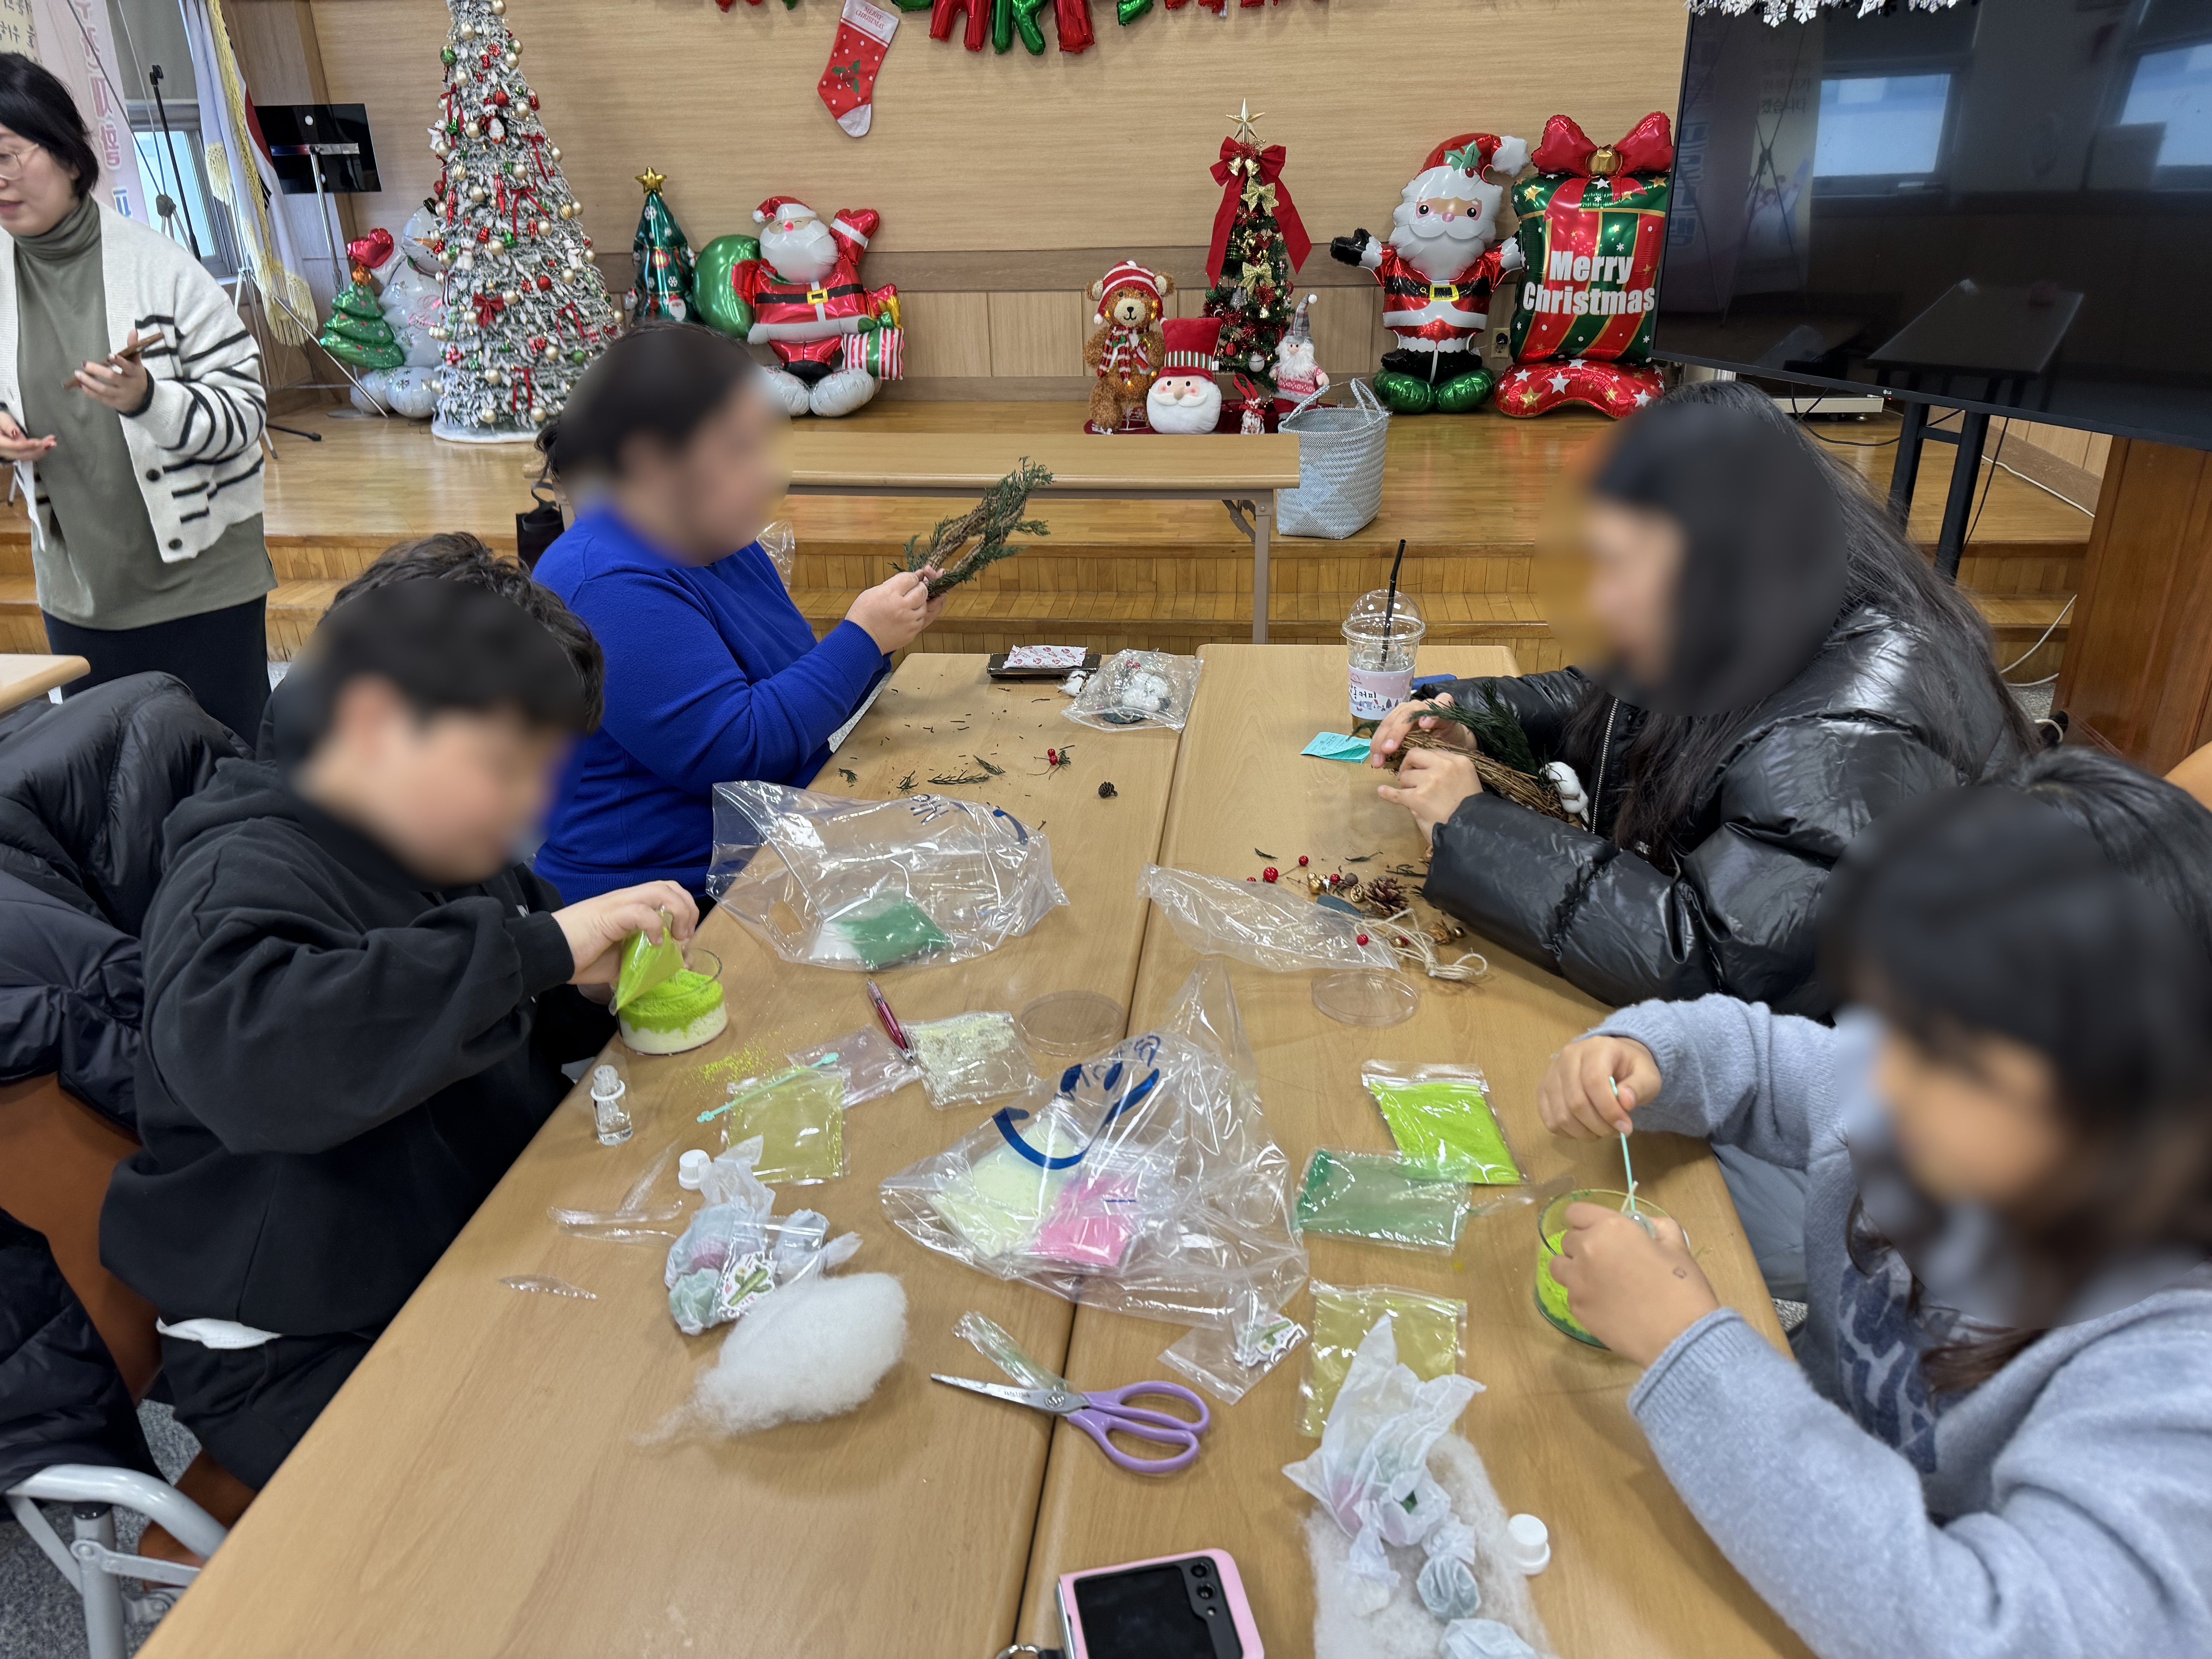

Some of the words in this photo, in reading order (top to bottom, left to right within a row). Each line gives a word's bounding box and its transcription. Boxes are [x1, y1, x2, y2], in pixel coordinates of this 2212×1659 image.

[855, 10, 885, 29] CHRISTMAS
[864, 6, 883, 20] MERRY
[1549, 251, 1635, 284] Merry
[1523, 281, 1655, 316] Christmas
